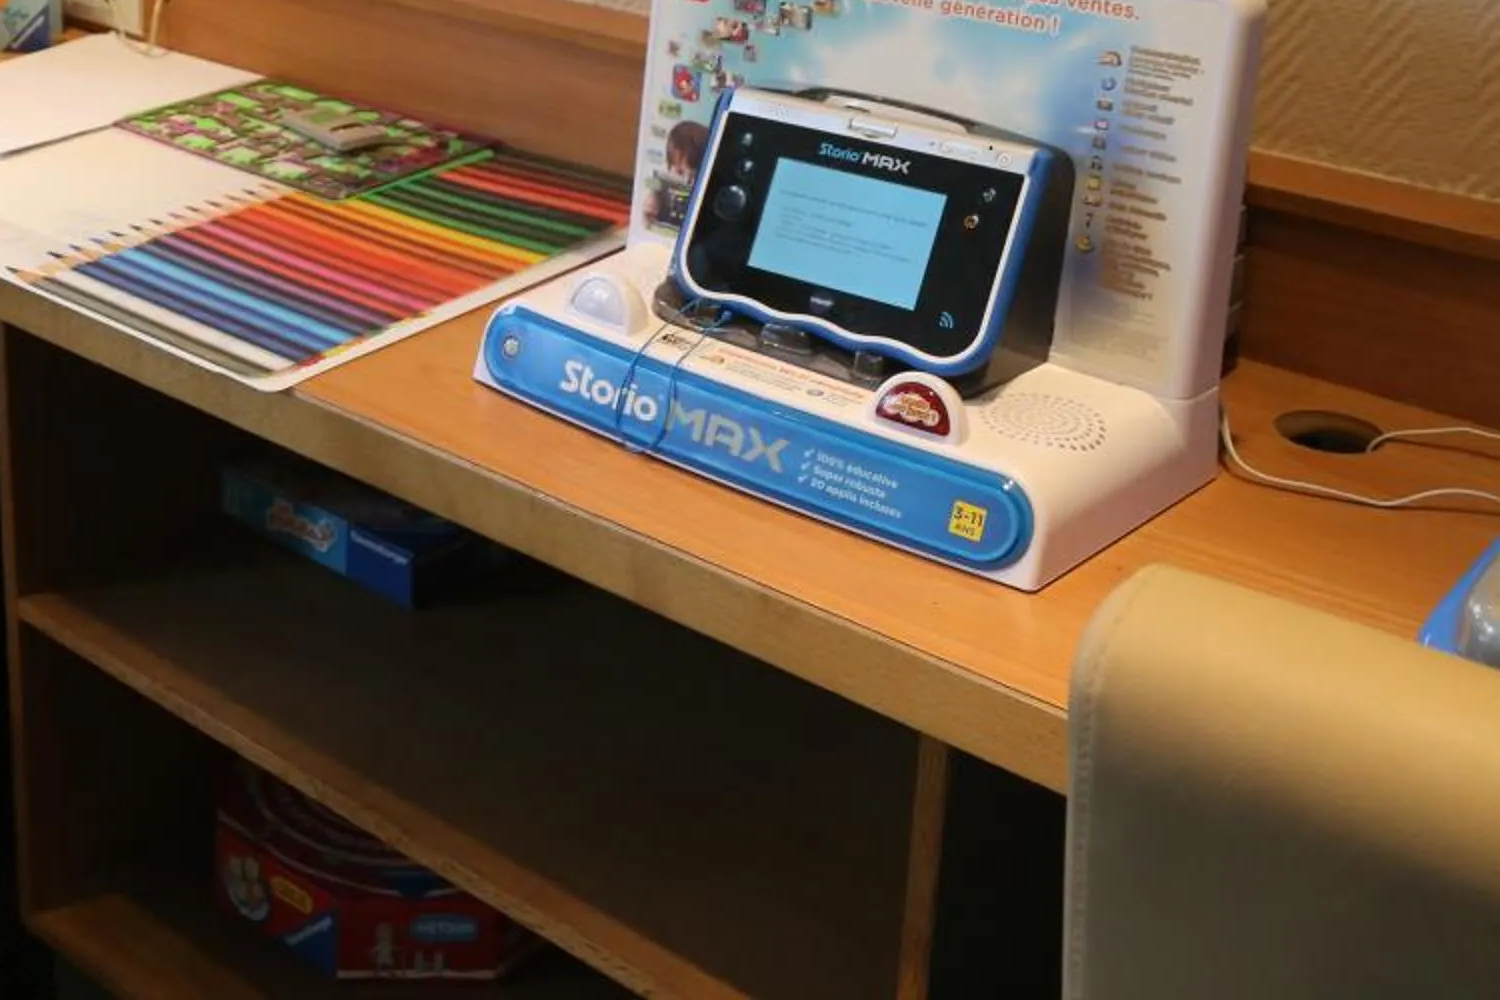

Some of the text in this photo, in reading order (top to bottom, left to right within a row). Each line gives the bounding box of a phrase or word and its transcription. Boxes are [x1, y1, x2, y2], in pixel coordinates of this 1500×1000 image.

[819, 142, 913, 174] Storio MAX
[560, 358, 658, 421] Storio
[666, 398, 790, 473] MAX
[953, 505, 984, 527] 3-11
